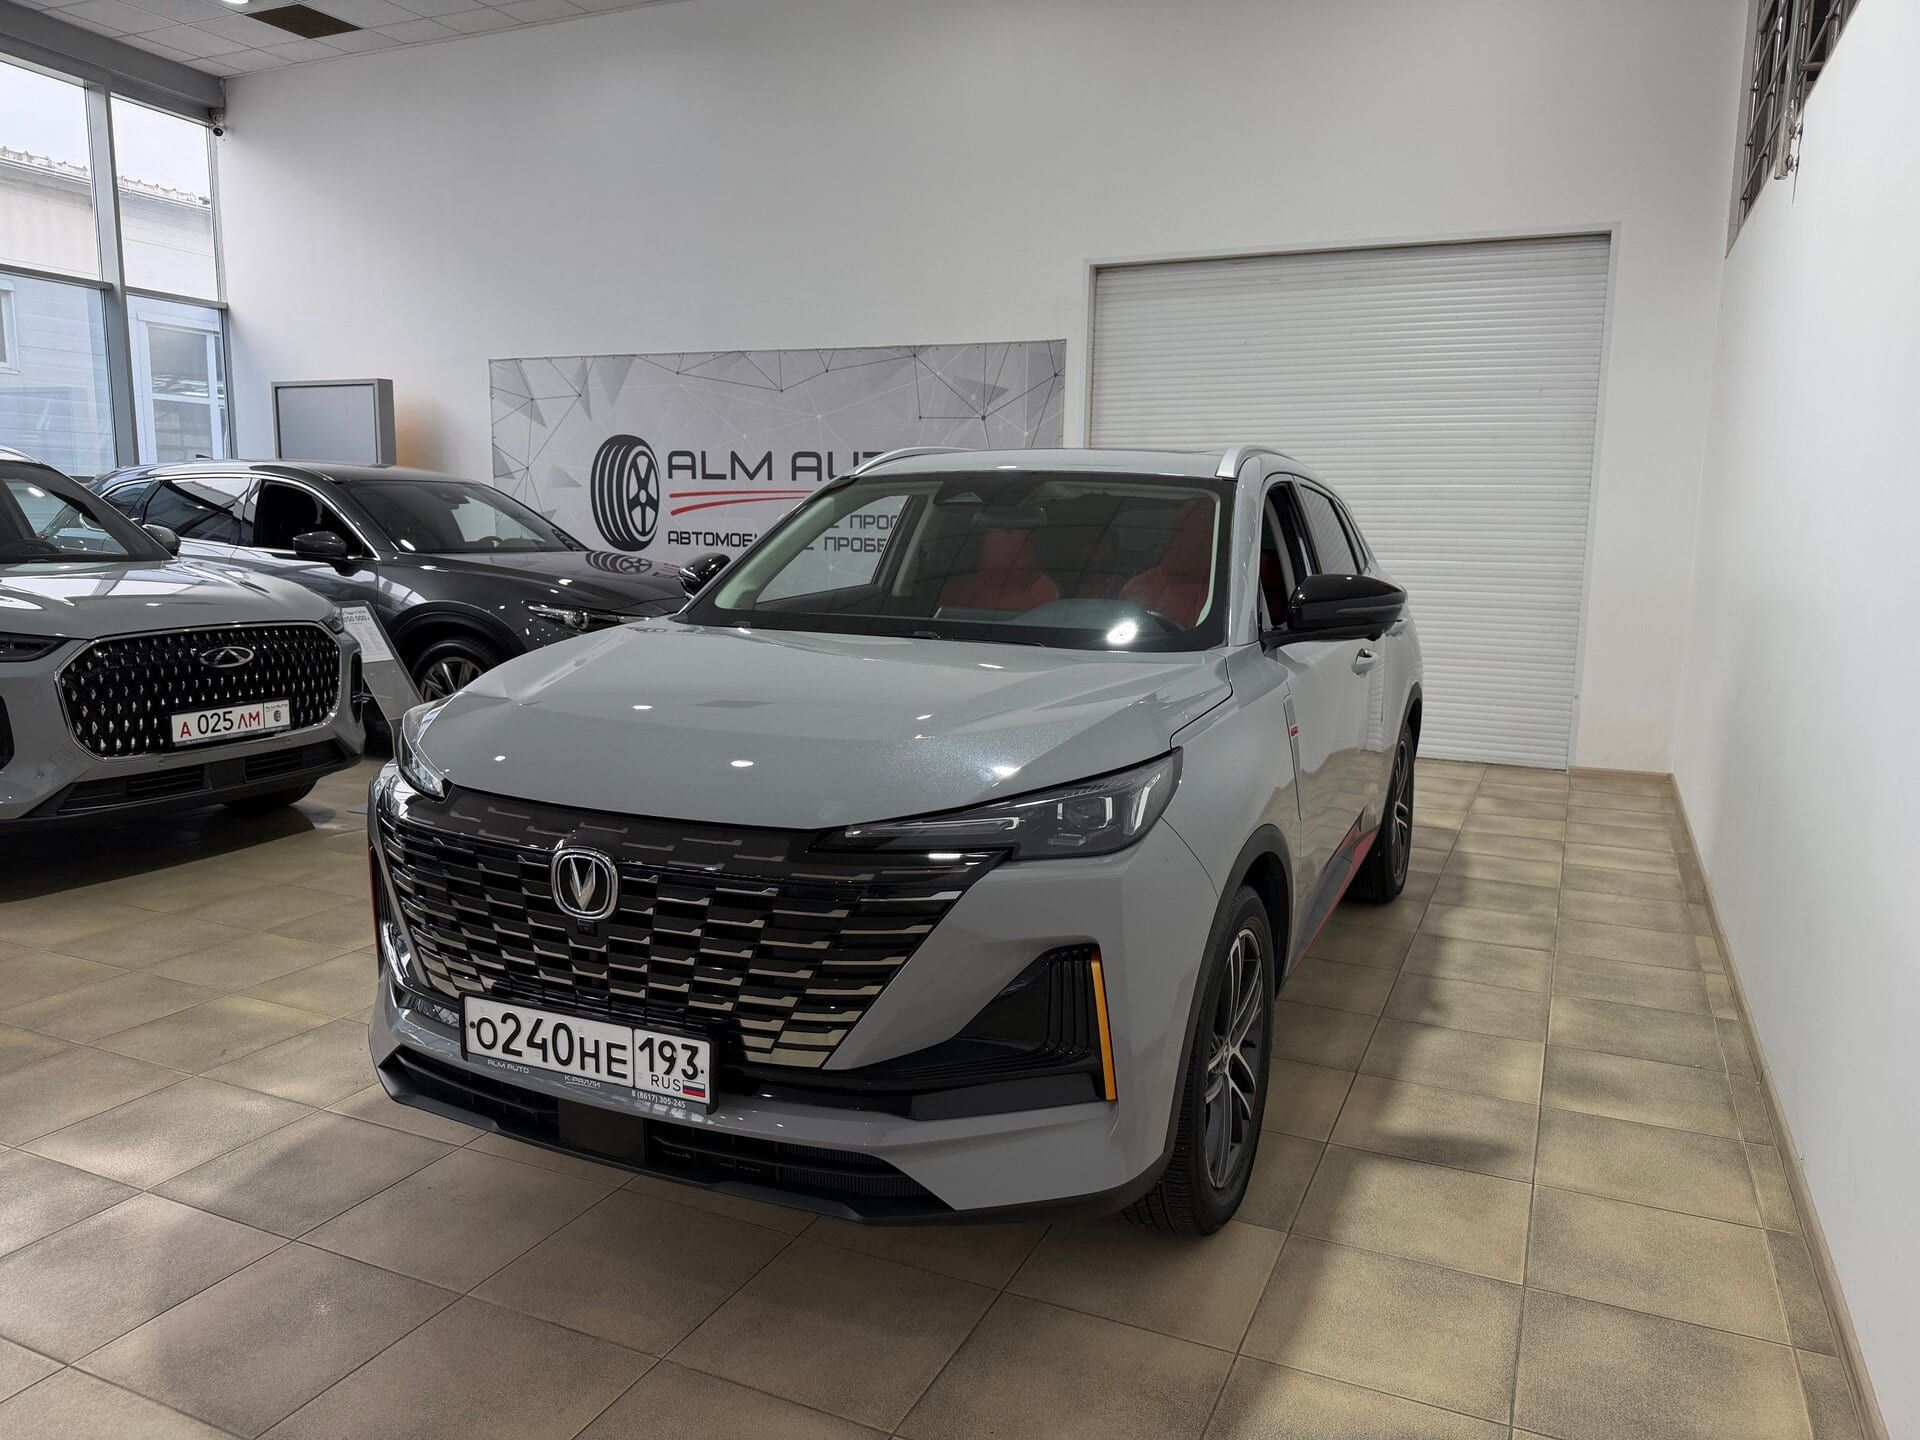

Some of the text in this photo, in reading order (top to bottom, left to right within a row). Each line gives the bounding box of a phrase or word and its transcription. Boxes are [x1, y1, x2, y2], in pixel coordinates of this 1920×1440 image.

[668, 450, 772, 481] ALM
[667, 530, 758, 548] АВТОМОБ
[197, 710, 234, 735] 025
[507, 1064, 530, 1074] AUTO
[638, 1037, 699, 1081] 193
[651, 1074, 682, 1092] RUS
